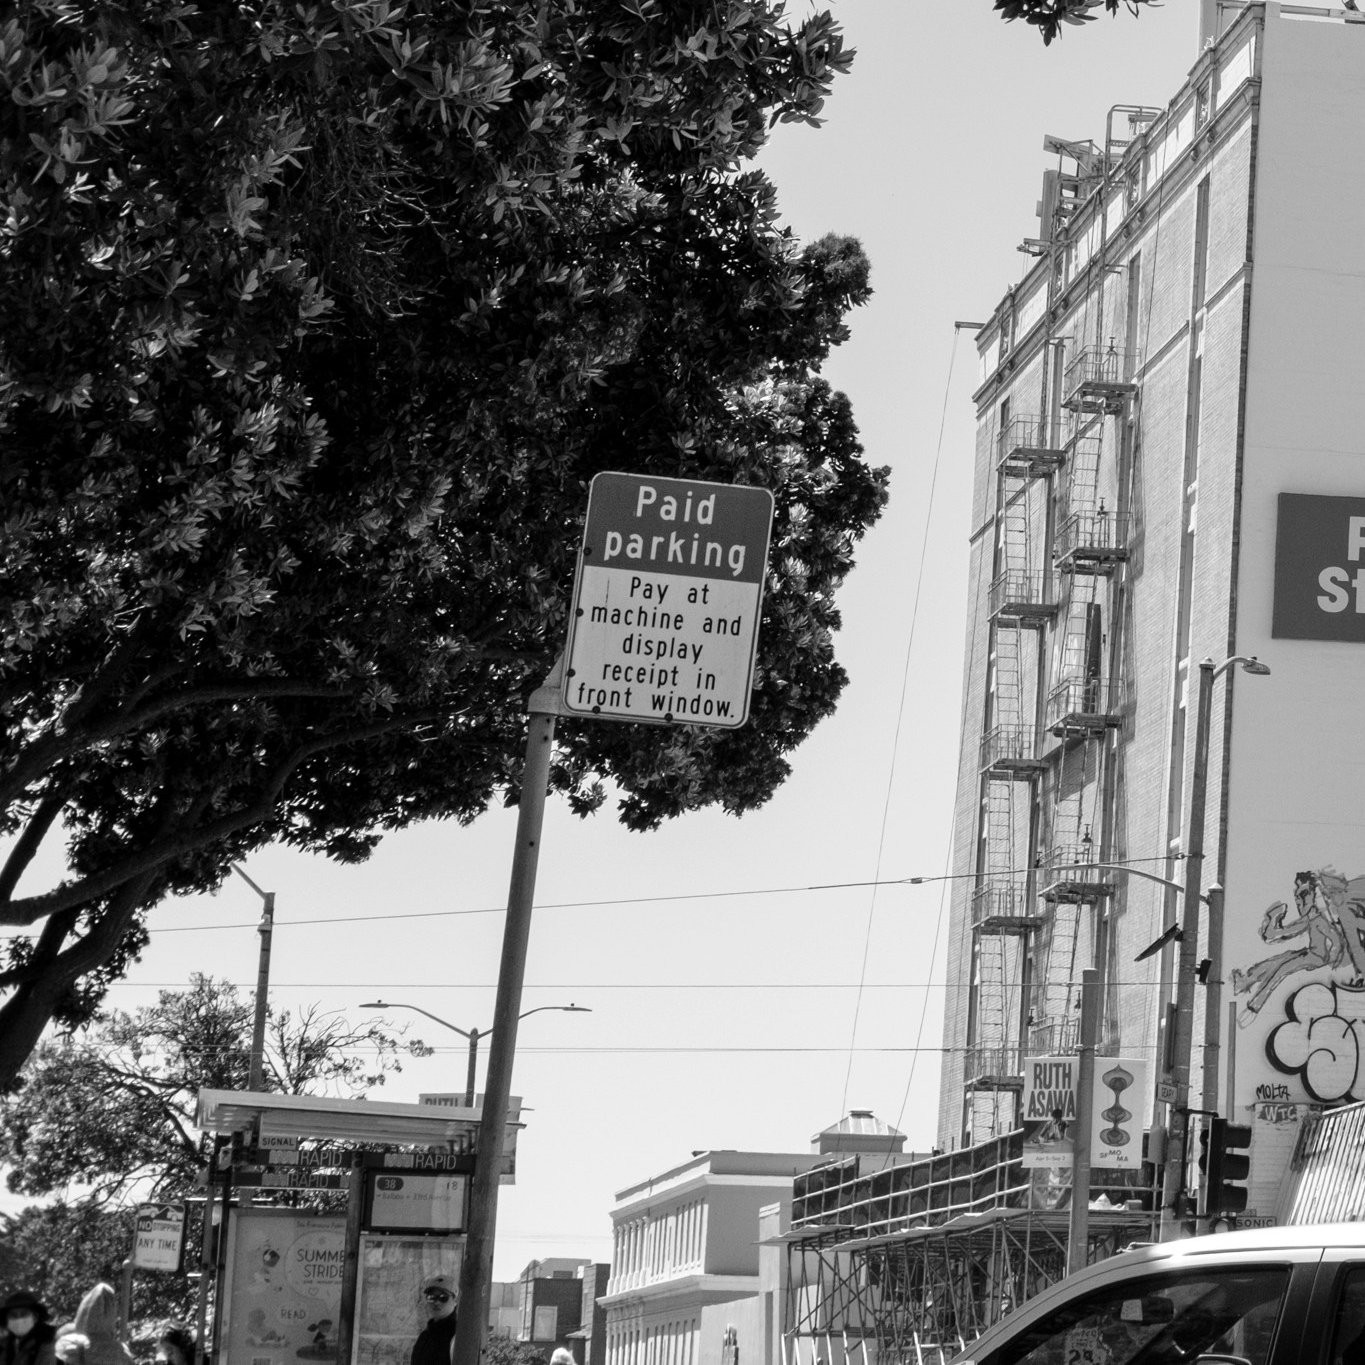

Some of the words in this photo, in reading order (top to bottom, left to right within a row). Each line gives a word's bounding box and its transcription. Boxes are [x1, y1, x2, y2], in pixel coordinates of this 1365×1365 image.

[636, 485, 716, 525] Paid
[604, 531, 746, 577] parking
[630, 576, 669, 604] Pay
[687, 583, 709, 605] at
[591, 605, 684, 630] machine
[703, 615, 742, 636] and
[623, 633, 703, 664] display
[602, 663, 679, 689] receipt
[697, 667, 716, 690] in
[578, 682, 632, 708] front
[652, 691, 735, 718] window.
[1033, 1062, 1072, 1090] RUTH
[1027, 1090, 1076, 1118] ASAWA
[262, 1137, 295, 1146] SIGNAL
[300, 1150, 343, 1166] RAPID
[415, 1154, 457, 1170] RAPID
[291, 1174, 329, 1188] RAPID
[384, 1178, 397, 1189] 38
[138, 1220, 152, 1231] NO
[138, 1238, 155, 1249] ANY
[158, 1238, 177, 1251] TIME
[280, 1308, 307, 1321] READ
